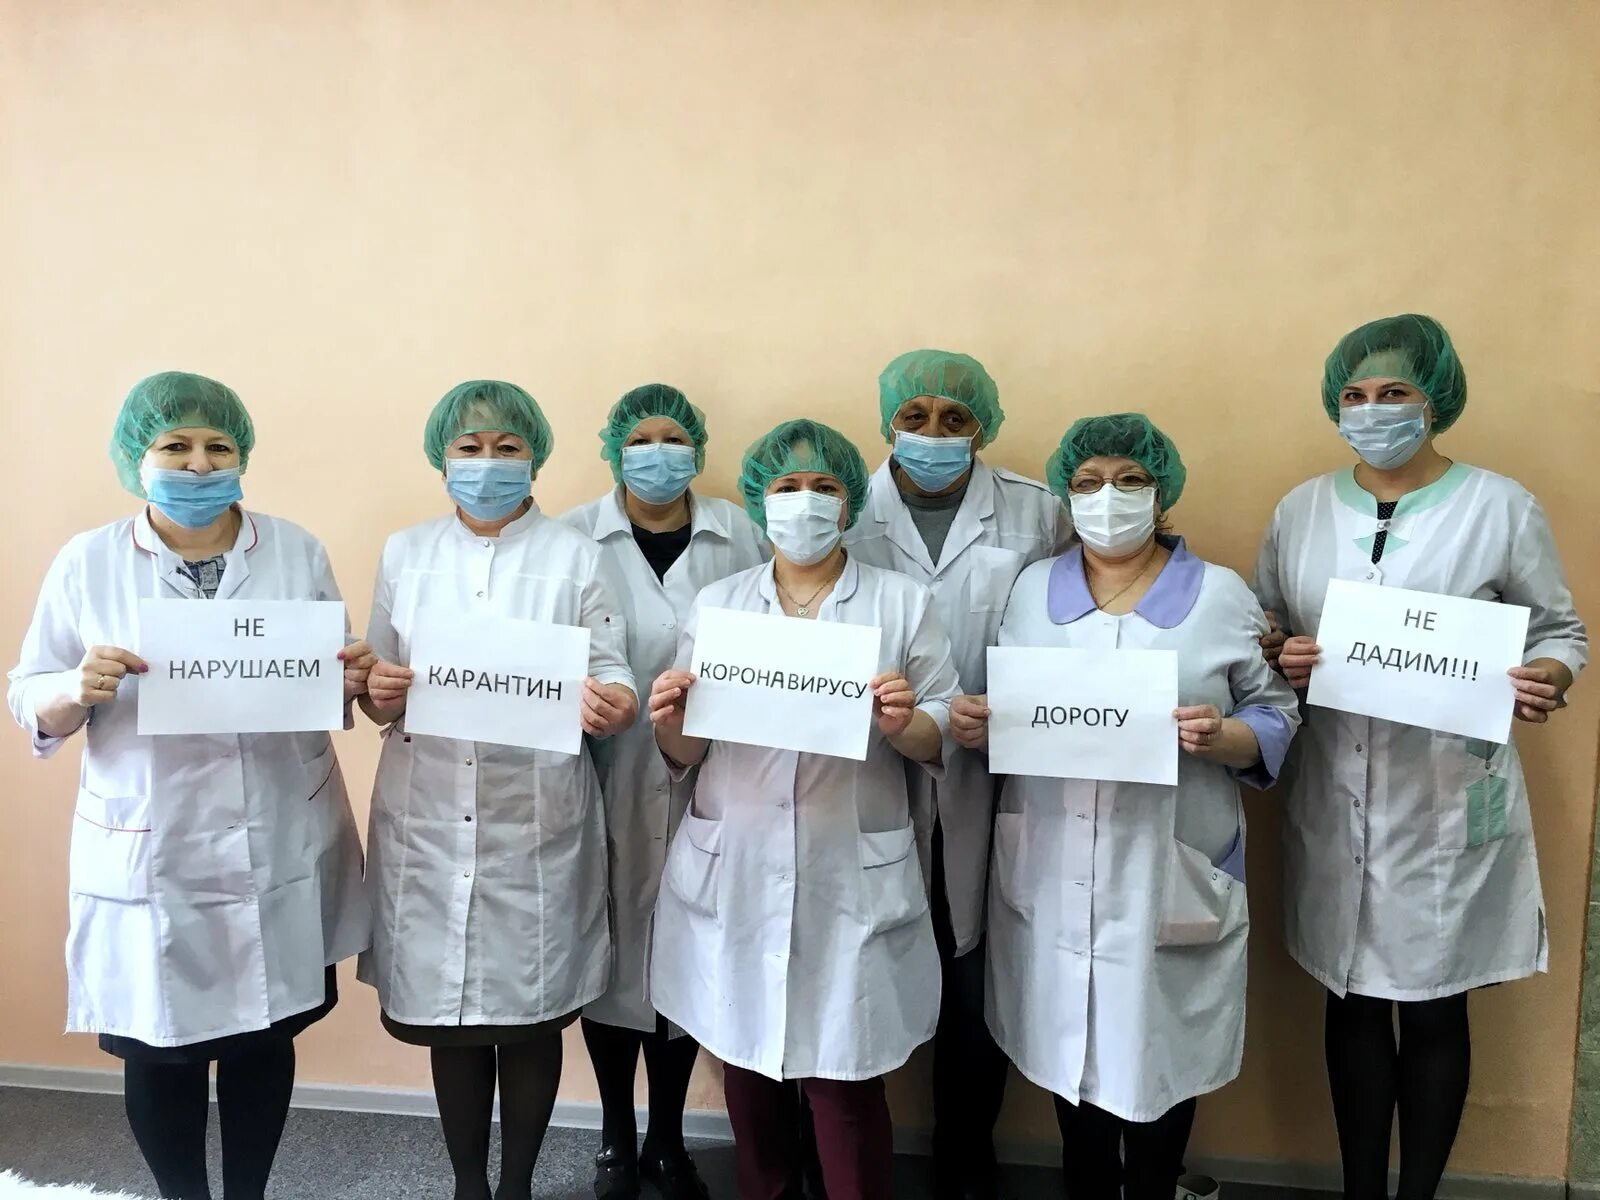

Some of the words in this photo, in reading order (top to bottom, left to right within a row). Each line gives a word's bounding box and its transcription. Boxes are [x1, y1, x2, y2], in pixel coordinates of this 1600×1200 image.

[233, 617, 265, 638] НЕ
[1404, 607, 1438, 632] НЕ
[168, 658, 321, 681] НАРУШАЕМ
[1346, 641, 1479, 682] ДАДИМ!!!
[428, 665, 562, 701] КАРАНТИН
[698, 660, 869, 700] КОРОНАВИРУСУ
[1031, 704, 1130, 730] ДОРОГУ
